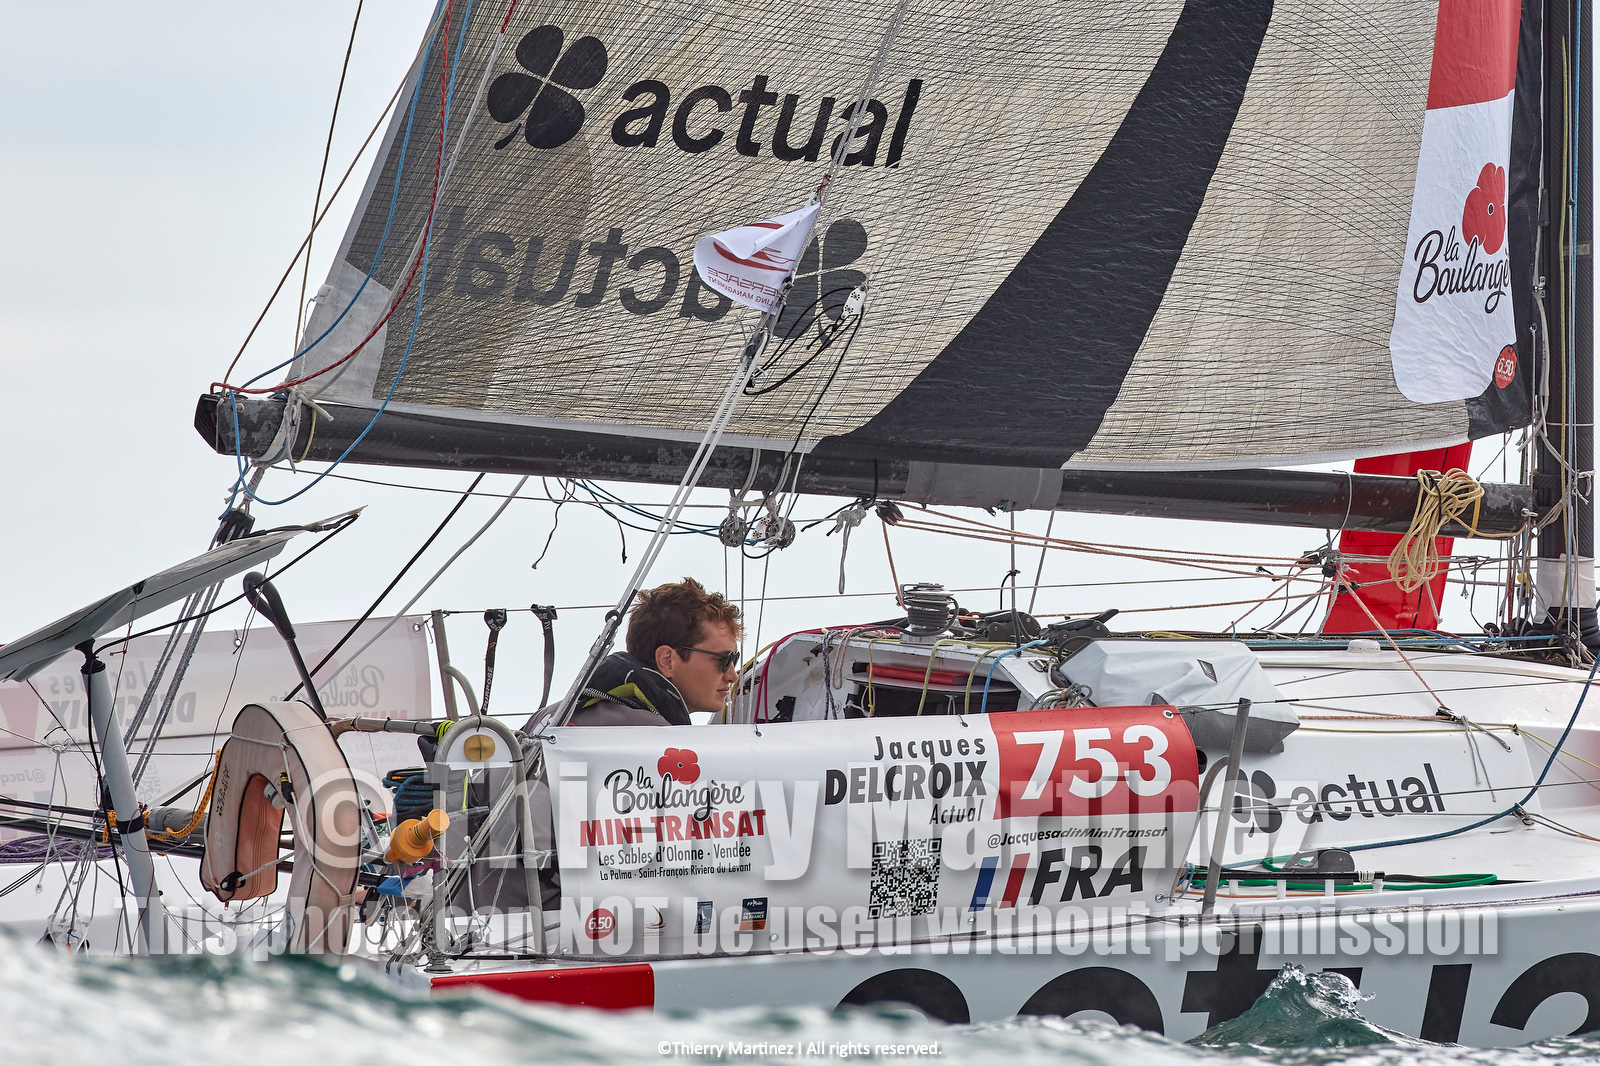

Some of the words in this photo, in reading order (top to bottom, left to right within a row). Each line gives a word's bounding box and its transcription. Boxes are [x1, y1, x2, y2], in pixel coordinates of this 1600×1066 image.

[611, 74, 923, 169] actual
[1443, 225, 1460, 262] la
[874, 735, 987, 764] Jacques
[1012, 724, 1172, 801] 753
[603, 768, 745, 821] Boulangère
[635, 766, 654, 789] la
[824, 760, 988, 806] DELCROIX
[1290, 762, 1446, 825] actual
[579, 817, 644, 847] MINI
[650, 809, 767, 843] TRANSAT
[929, 799, 983, 825] Actual
[599, 850, 615, 867] Les
[618, 846, 653, 865] Sables
[712, 841, 751, 860] Vendée
[987, 826, 1168, 849] @JacquesaditMiniTransat
[600, 870, 609, 881] La
[610, 868, 632, 881] Palma
[638, 864, 689, 879] Saint-François
[690, 864, 715, 876] Riviera
[717, 863, 726, 874] du
[728, 862, 751, 873] Levant
[1026, 846, 1149, 906] FRA
[588, 916, 612, 931] 6.50
